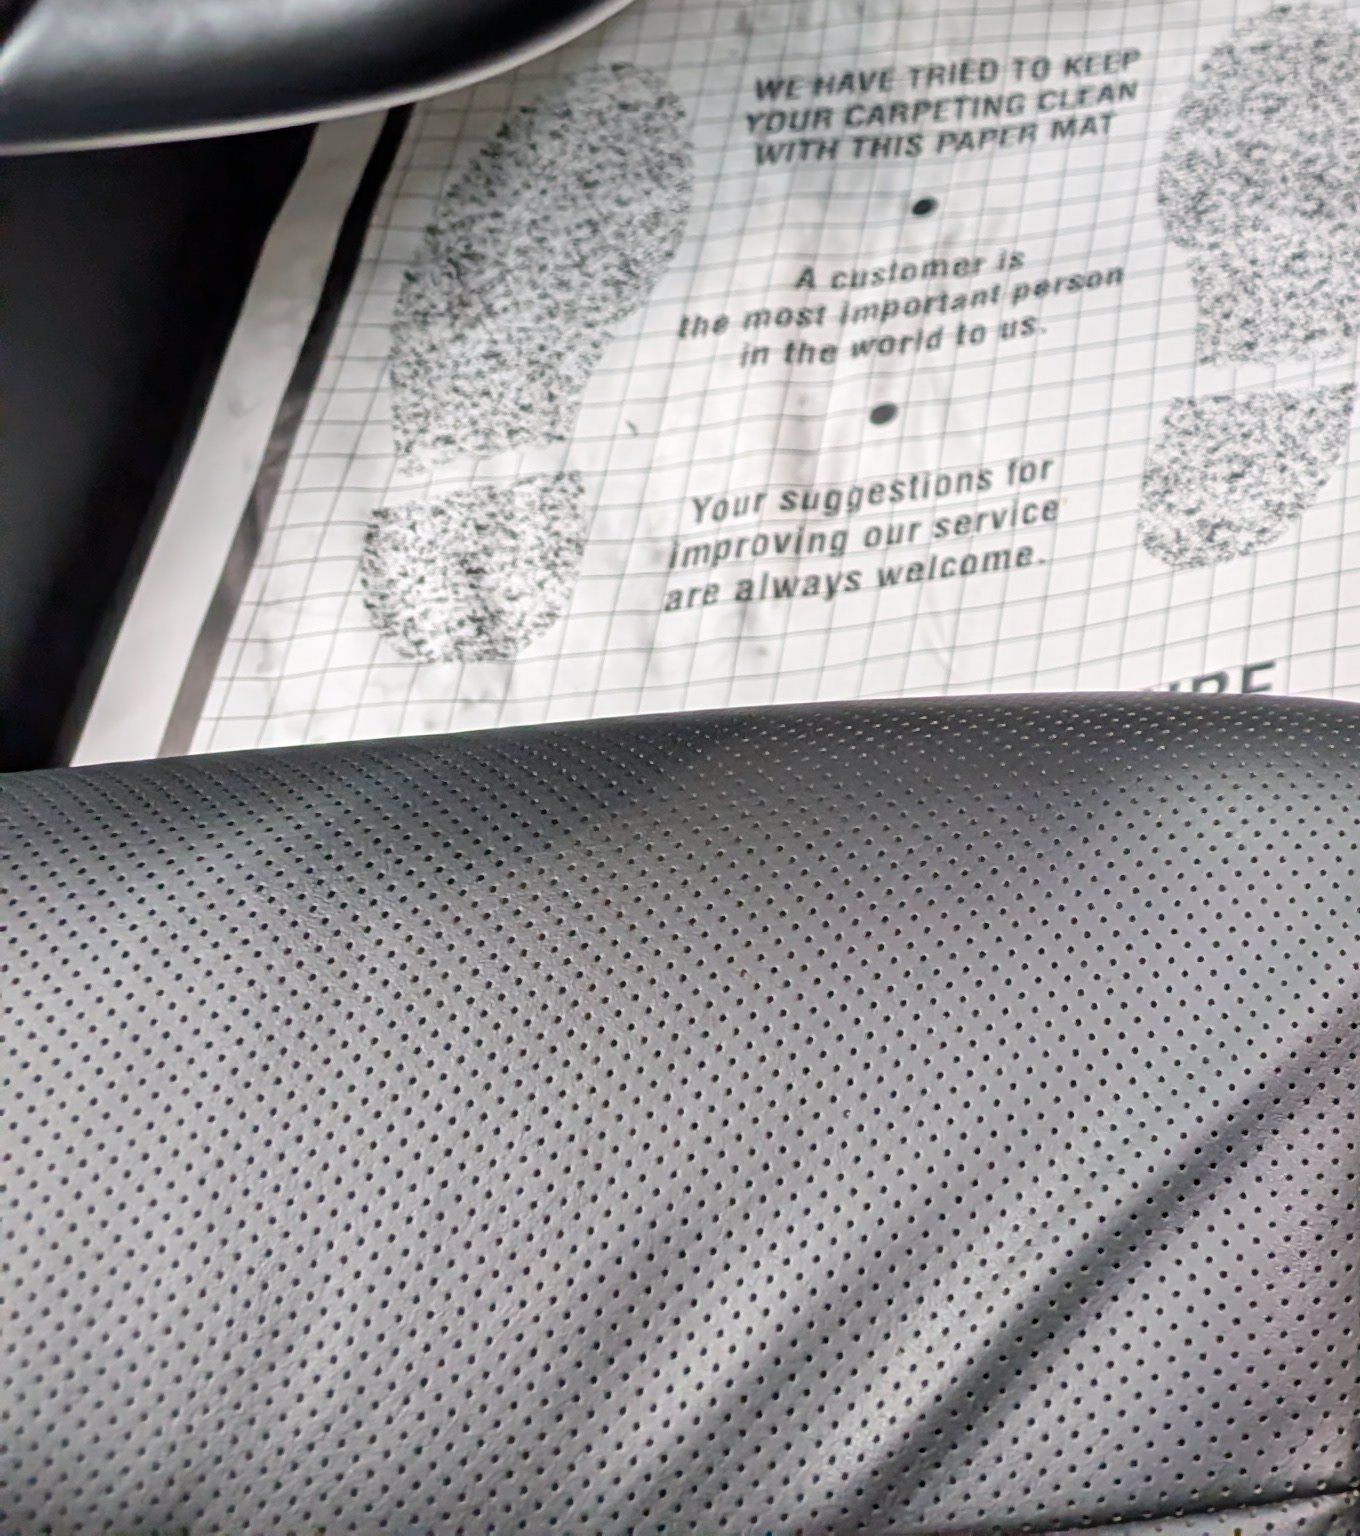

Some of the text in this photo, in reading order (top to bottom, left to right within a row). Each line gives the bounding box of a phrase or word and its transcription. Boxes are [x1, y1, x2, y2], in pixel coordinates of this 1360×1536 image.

[754, 47, 1142, 102] WE HAVE TRIED TO KEEP
[746, 80, 1139, 135] YOUR CARPETING CLEAN
[754, 111, 1117, 166] WITH THIS PAPER MAT
[794, 248, 1025, 291] A customer is
[677, 265, 1125, 340] the most important person
[740, 313, 1047, 369] in the world to us.
[691, 456, 1054, 525] Your suggestions for
[667, 494, 1061, 571] improving our service
[663, 544, 1047, 613] are always welcome.
